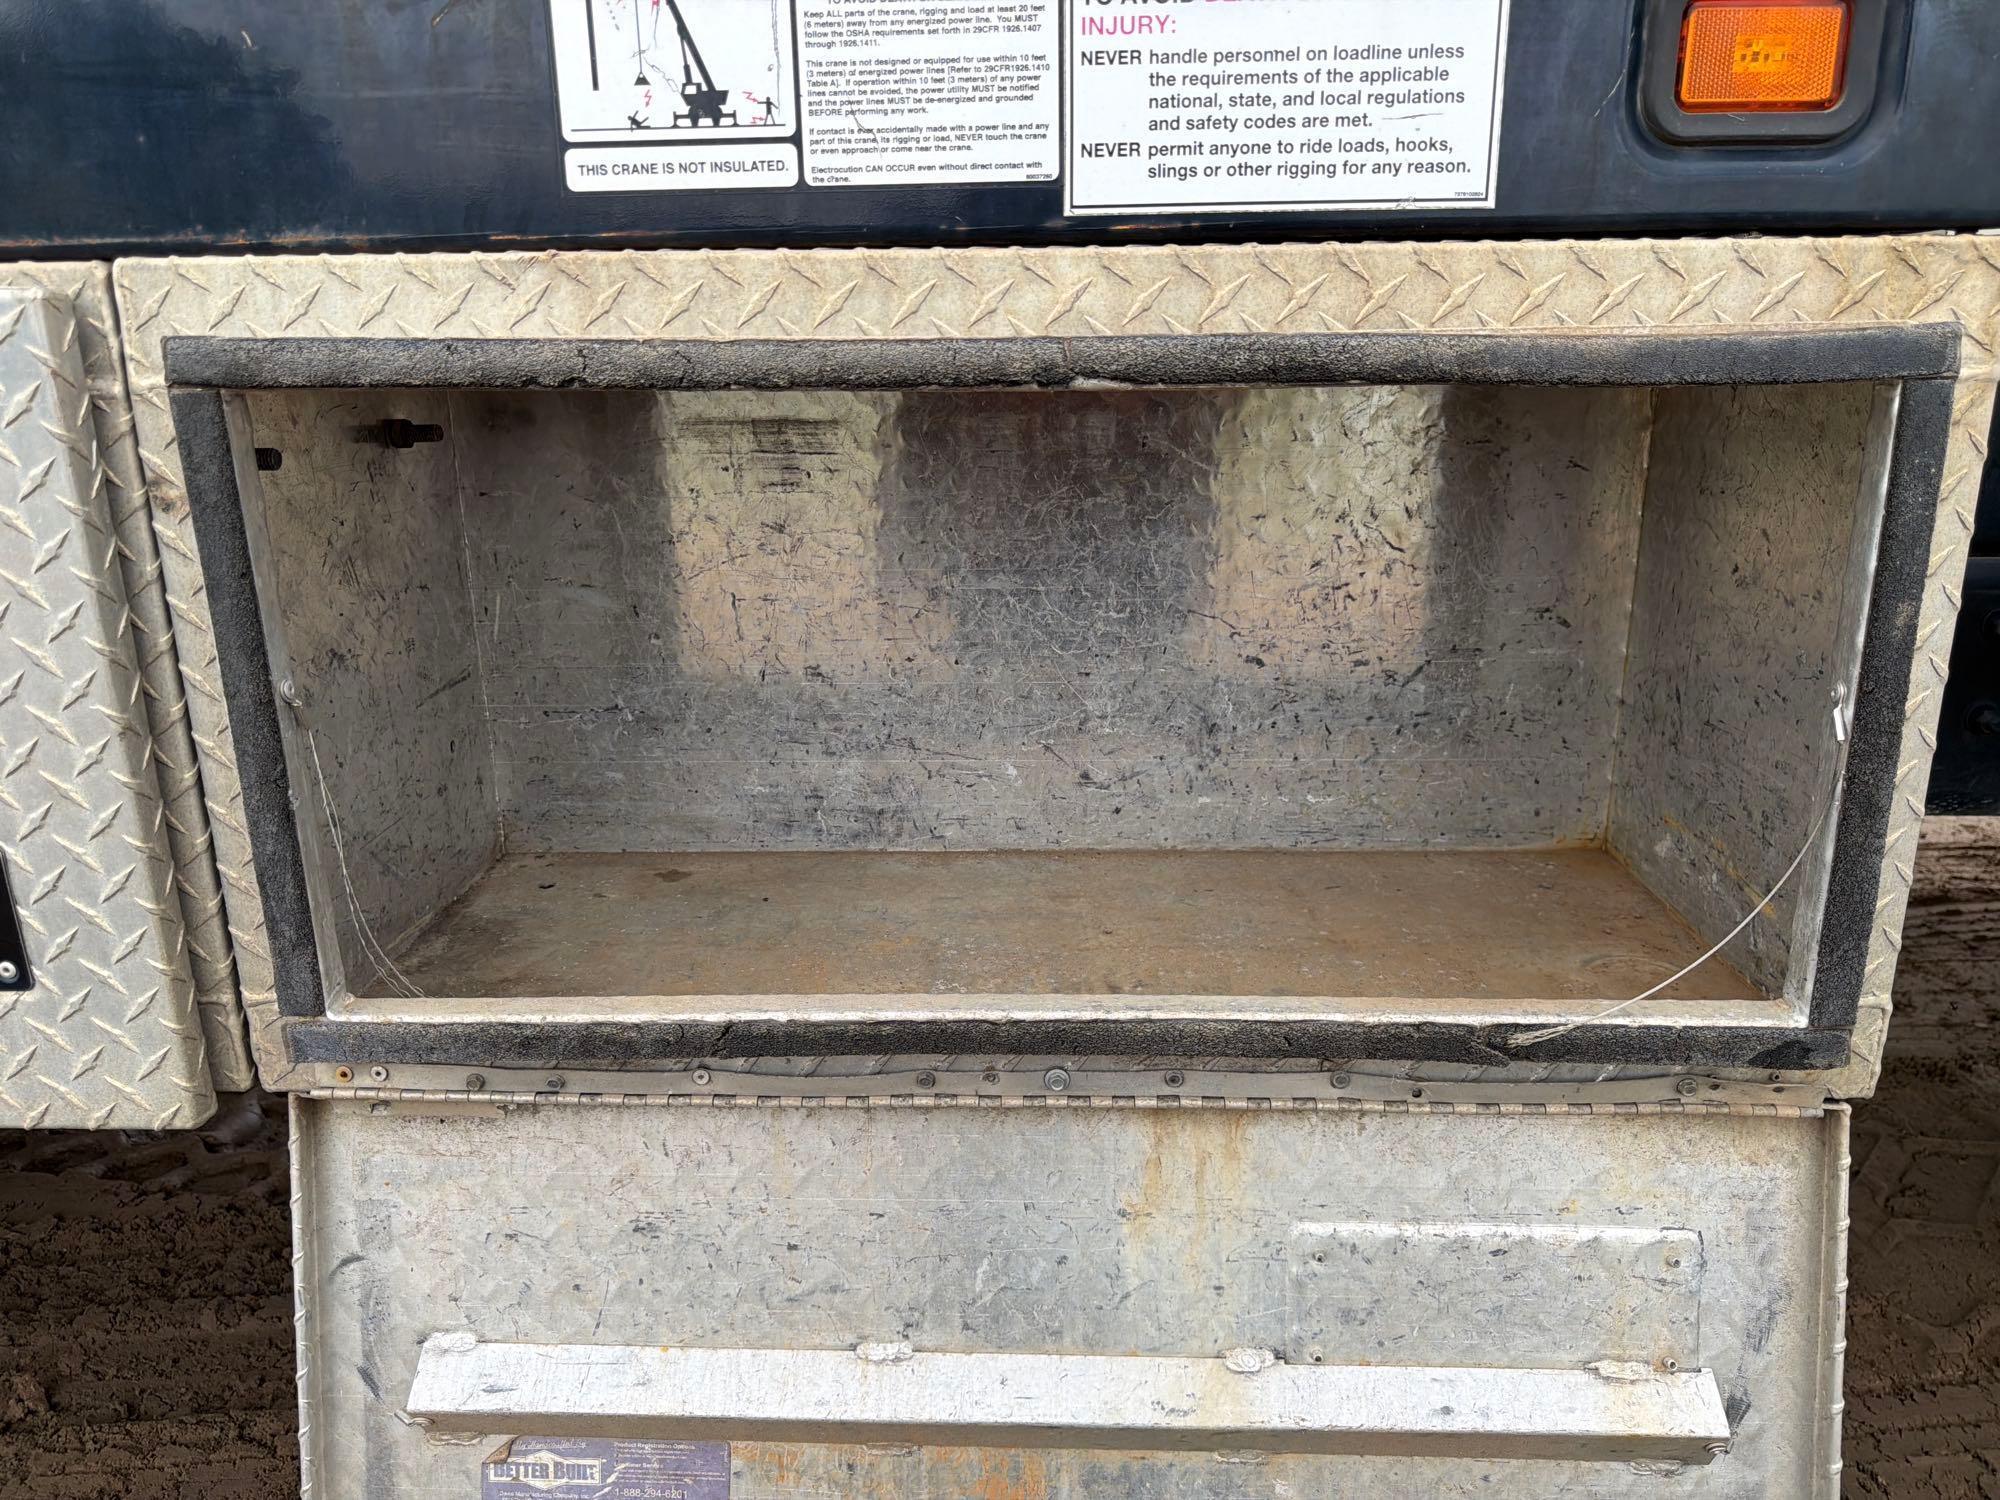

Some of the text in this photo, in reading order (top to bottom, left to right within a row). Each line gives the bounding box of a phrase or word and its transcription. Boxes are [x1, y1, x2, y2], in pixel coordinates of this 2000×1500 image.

[803, 11, 824, 19] Keep
[844, 10, 865, 18] parts
[891, 9, 917, 17] crane,
[919, 7, 948, 16] rigging
[1018, 4, 1028, 12] 20
[813, 20, 844, 28] meters)
[906, 17, 946, 26] energized
[947, 17, 973, 25] power
[1014, 14, 1037, 22] MUST
[1081, 15, 1176, 35] INJURY:
[845, 29, 870, 37] OSHA
[871, 28, 925, 37] requirements
[972, 25, 999, 33] 29CFR
[804, 40, 836, 49] through
[874, 57, 911, 67] designed
[923, 56, 961, 65] equipped
[1080, 43, 1464, 66] NEVER handle personnel on loadline unless
[816, 70, 846, 78] meters)
[858, 68, 897, 77] energized
[899, 68, 924, 76] power
[947, 65, 971, 75] [Refer
[1148, 66, 1449, 89] the requirements of the applicable
[806, 79, 828, 87] Table
[852, 78, 890, 87] operation
[919, 76, 928, 84] 10
[957, 75, 988, 83] meters)
[1016, 75, 1041, 83] power
[869, 87, 903, 96] avoided,
[920, 87, 944, 95] power
[947, 85, 969, 94] utility
[971, 84, 994, 92] MUST
[1009, 83, 1039, 91] notified
[807, 99, 822, 107] and
[839, 99, 864, 107] power
[887, 96, 910, 104] MUST
[924, 95, 976, 104] de-energized
[994, 93, 1033, 103] grounded
[1148, 88, 1464, 110] national, state, and local regulations
[808, 108, 843, 116] BEFORE
[844, 107, 888, 117] performing
[1148, 112, 1372, 133] and safety codes are met.
[1080, 136, 1452, 160] NEVER permit anyone to ride loads, hooks,
[577, 160, 788, 176] THIS CRANE IS NOT INSULATED.
[885, 164, 915, 172] OCCUR
[969, 162, 992, 170] direct
[1147, 159, 1470, 181] slings or other rigging for any reason.
[614, 1486, 689, 1499] 1-888-294-6201
